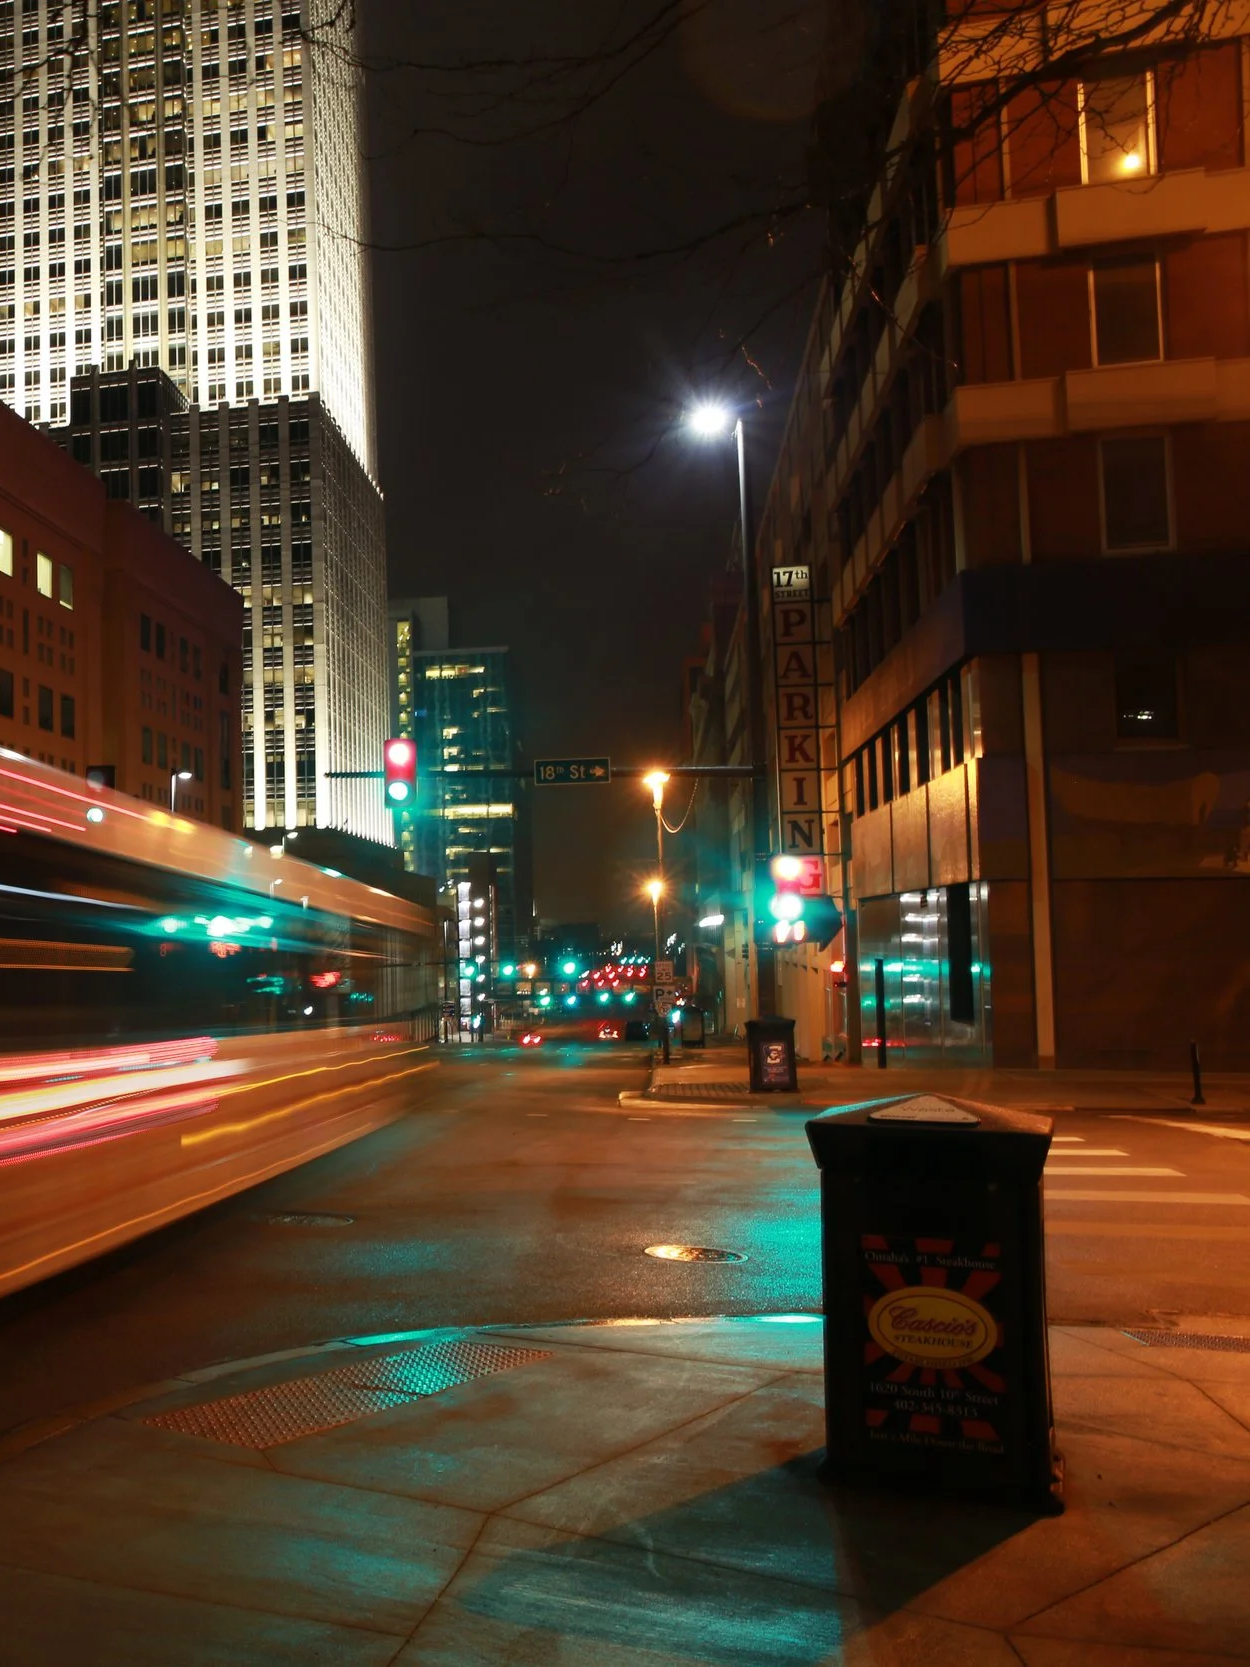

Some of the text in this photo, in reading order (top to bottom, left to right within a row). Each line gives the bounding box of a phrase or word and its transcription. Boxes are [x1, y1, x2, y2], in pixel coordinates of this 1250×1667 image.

[774, 570, 808, 588] 17th
[775, 590, 808, 599] STREET
[570, 765, 585, 779] St
[657, 972, 671, 980] 25
[864, 1250, 996, 1270] Omaha's #1 Steakhouse
[889, 1306, 977, 1334] Cascio's
[894, 1335, 973, 1349] STEAKHOUSE
[870, 1380, 898, 1394] 1620
[901, 1384, 935, 1398] South
[965, 1391, 999, 1405] Street
